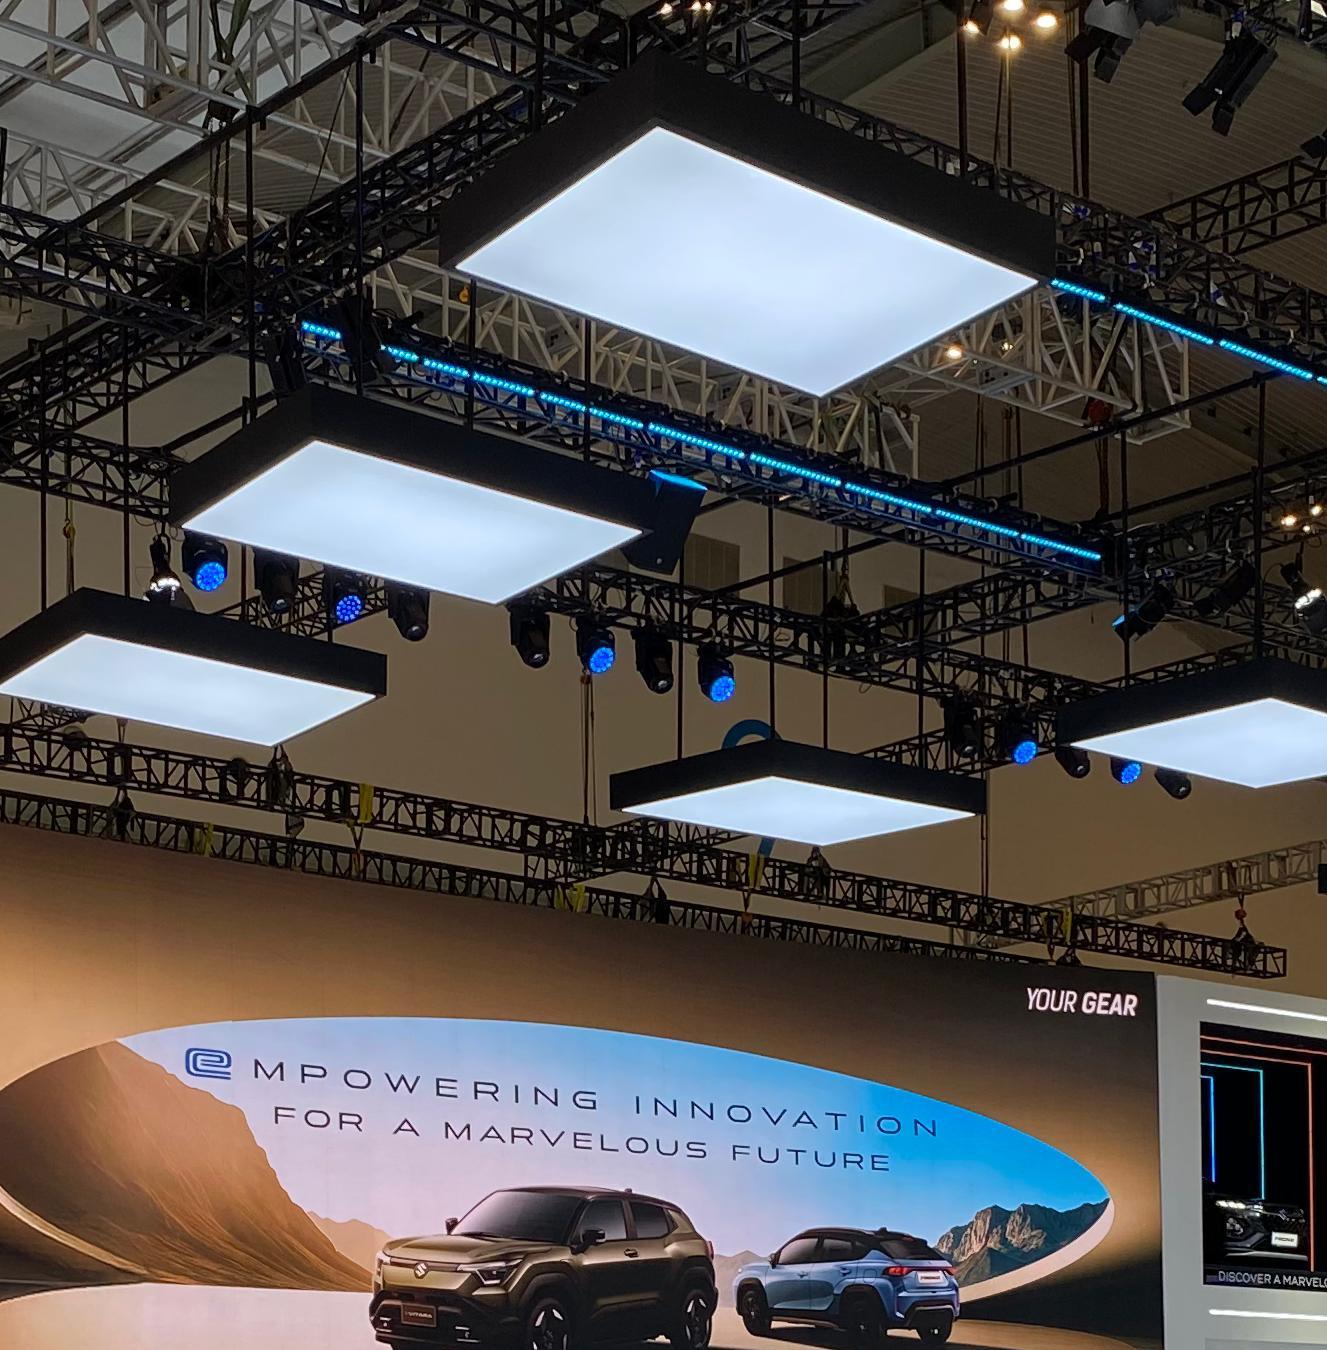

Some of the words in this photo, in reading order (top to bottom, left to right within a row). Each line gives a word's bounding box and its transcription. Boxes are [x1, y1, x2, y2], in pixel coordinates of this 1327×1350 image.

[1027, 987, 1077, 1013] YOUR
[1081, 991, 1138, 1017] GEAR
[635, 1096, 937, 1137] INNOVATION
[274, 1106, 363, 1132] FOR
[393, 1118, 420, 1137] A
[444, 1121, 707, 1159] MARVELOUS
[732, 1144, 890, 1172] FUTURE
[1218, 1270, 1271, 1284] DISCOVER
[1273, 1275, 1282, 1284] A
